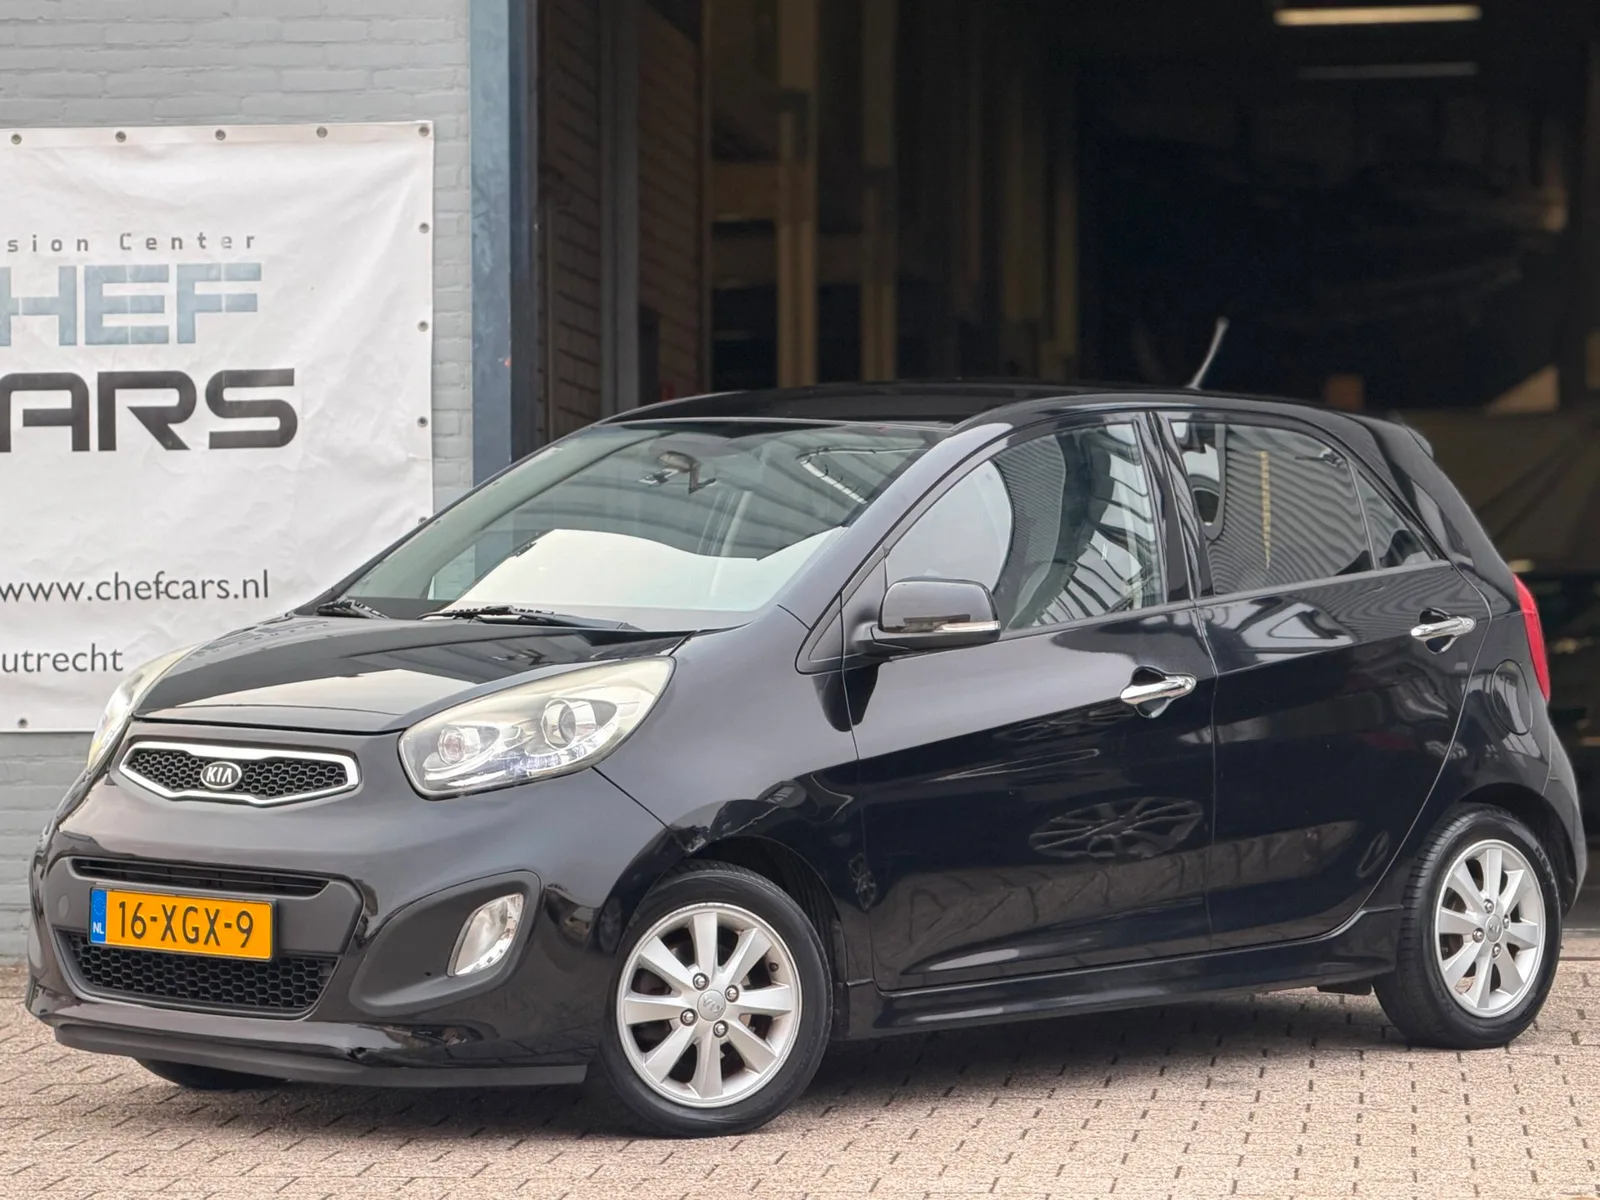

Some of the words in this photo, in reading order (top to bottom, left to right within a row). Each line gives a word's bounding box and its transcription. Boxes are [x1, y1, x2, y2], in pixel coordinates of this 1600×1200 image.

[7, 234, 89, 252] sion
[118, 232, 255, 251] Center
[0, 262, 262, 346] HEF
[0, 368, 298, 453] ARS
[0, 569, 269, 602] www.chefcars.nl
[2, 643, 124, 673] utrecht
[205, 765, 234, 784] KIA
[92, 922, 105, 935] NL
[119, 901, 254, 948] 16-XGX-9
